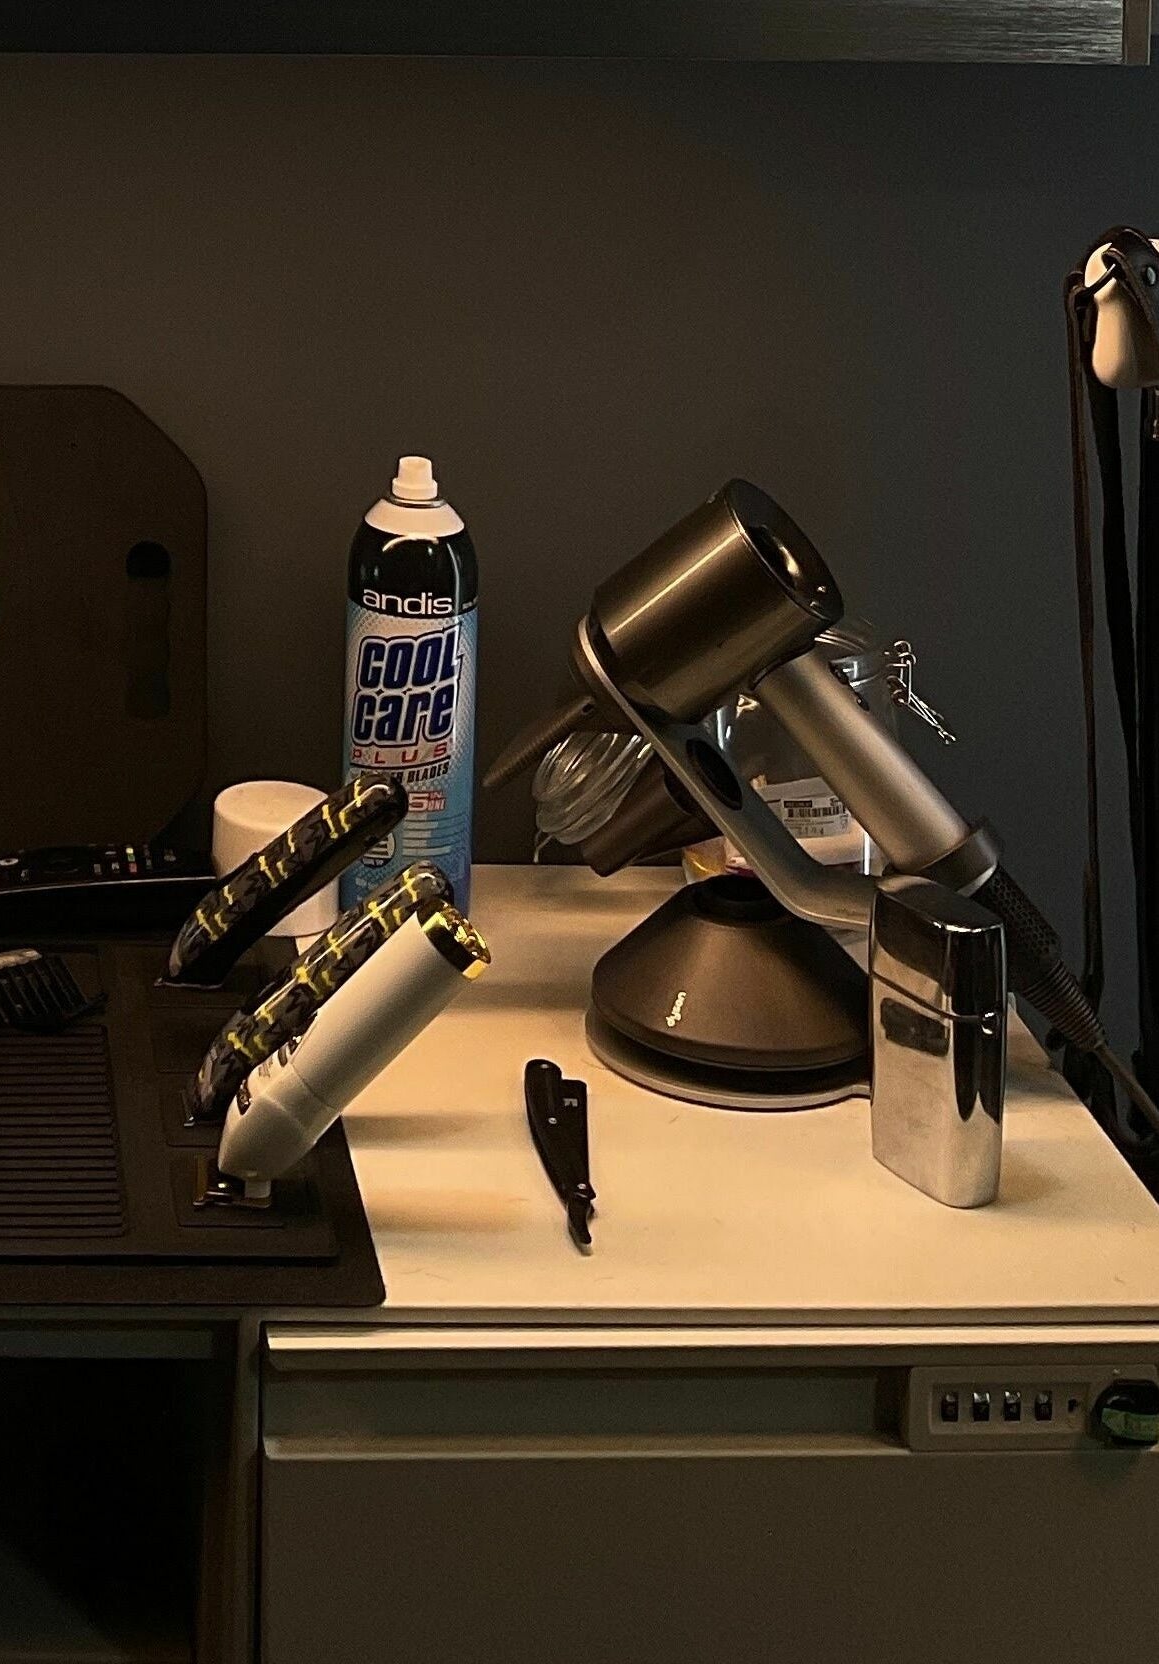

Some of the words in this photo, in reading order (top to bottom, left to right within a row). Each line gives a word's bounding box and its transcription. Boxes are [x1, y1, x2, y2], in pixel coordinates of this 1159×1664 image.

[362, 588, 453, 615] andis
[351, 742, 448, 764] PLUS
[407, 761, 450, 783] BLADES
[408, 791, 429, 812] 5
[665, 990, 687, 1027] dyson
